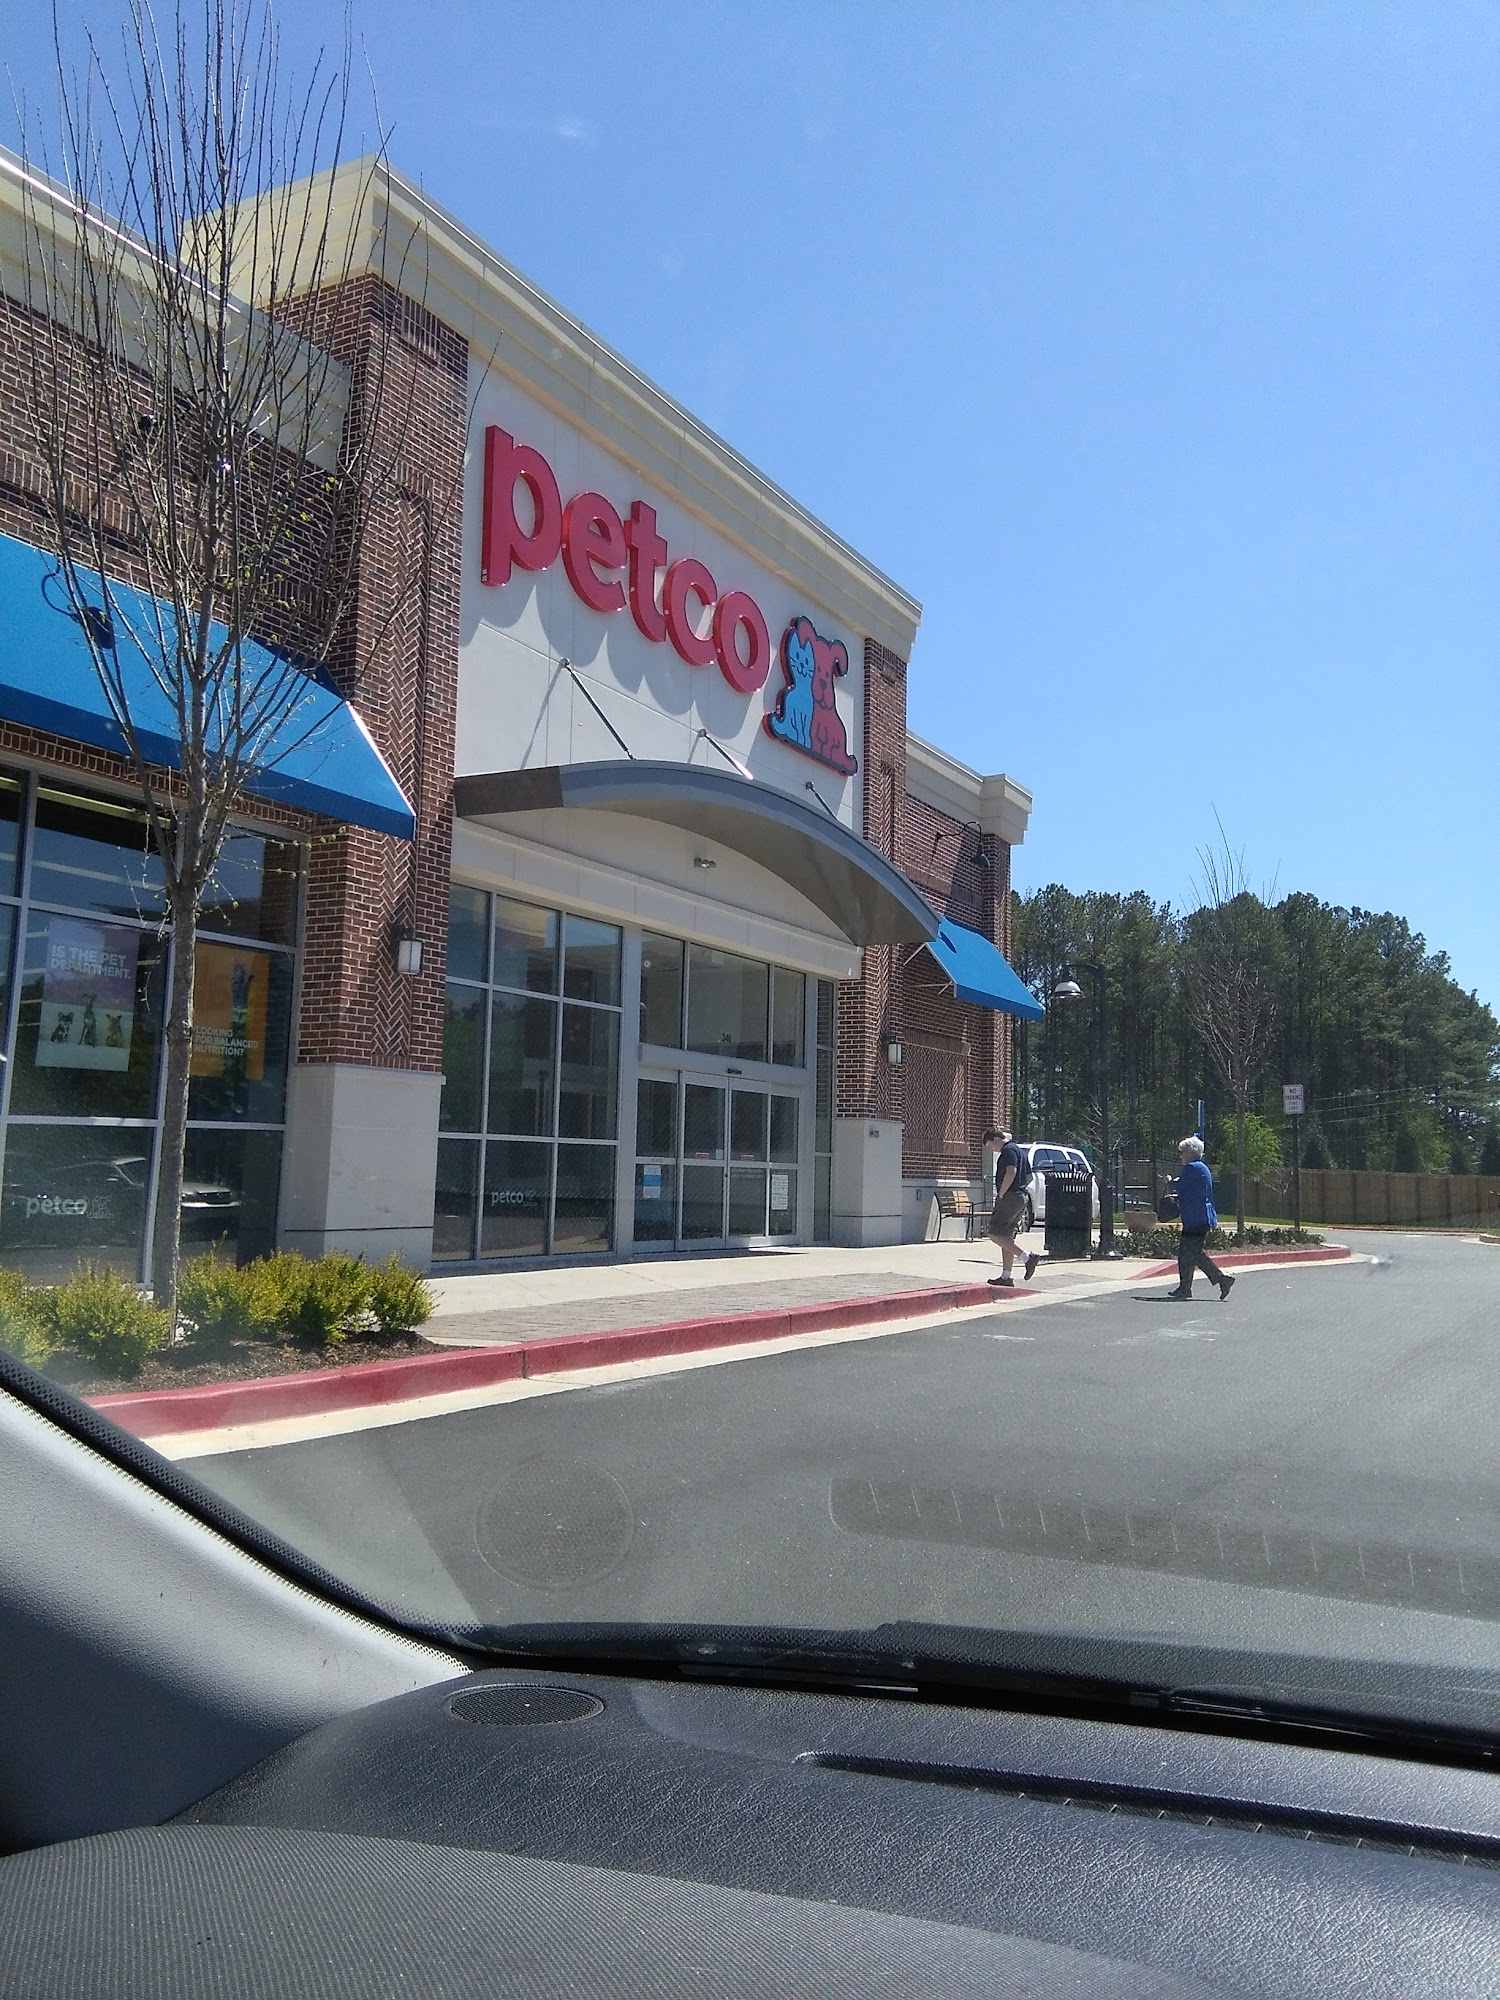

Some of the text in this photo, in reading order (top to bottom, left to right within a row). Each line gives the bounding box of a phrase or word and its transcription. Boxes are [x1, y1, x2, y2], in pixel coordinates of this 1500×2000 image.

[481, 424, 770, 694] petco
[51, 944, 127, 968] IS THE PET
[50, 957, 132, 980] DEPARTMENT.
[195, 1025, 234, 1038] LOOKING
[194, 1043, 245, 1057] NUTRITION?
[195, 1035, 259, 1049] FOR BALANCED
[25, 1195, 88, 1219] petco
[490, 1190, 524, 1207] petco
